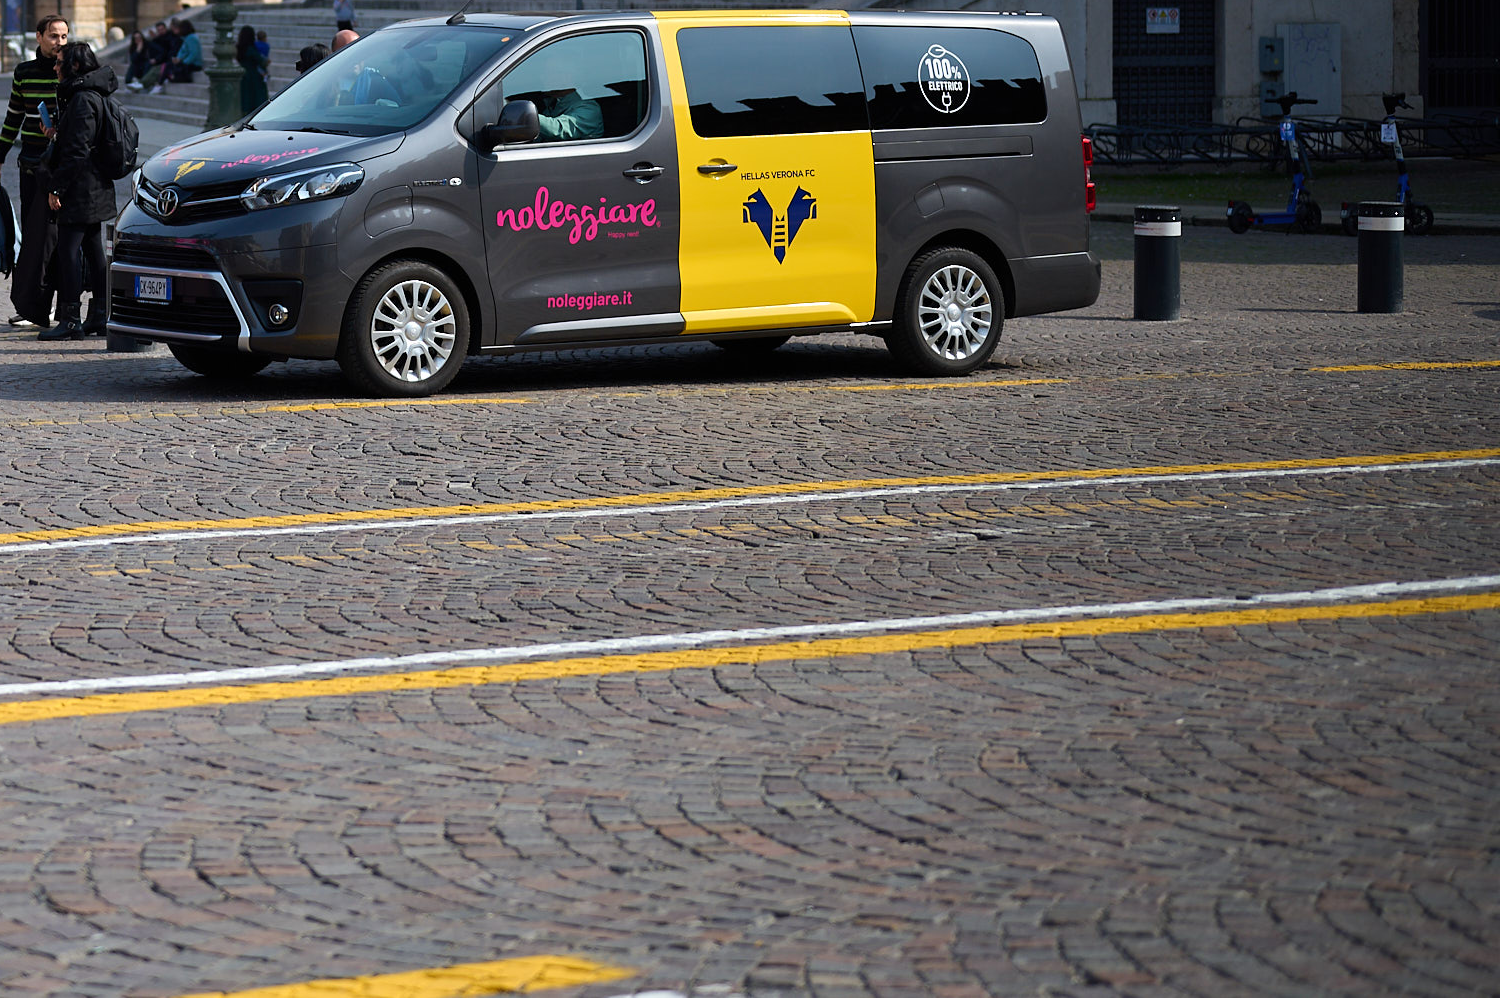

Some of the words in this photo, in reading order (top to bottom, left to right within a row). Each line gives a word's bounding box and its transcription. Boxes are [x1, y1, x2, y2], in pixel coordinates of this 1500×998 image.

[924, 58, 962, 79] 100%
[928, 81, 963, 91] ELETTRICO
[220, 147, 319, 169] noleggiare
[740, 171, 770, 181] HELLAS
[771, 169, 804, 179] VERONA
[805, 169, 815, 177] FC
[496, 186, 658, 245] noleggiare
[547, 290, 633, 311] noleggiare.it
